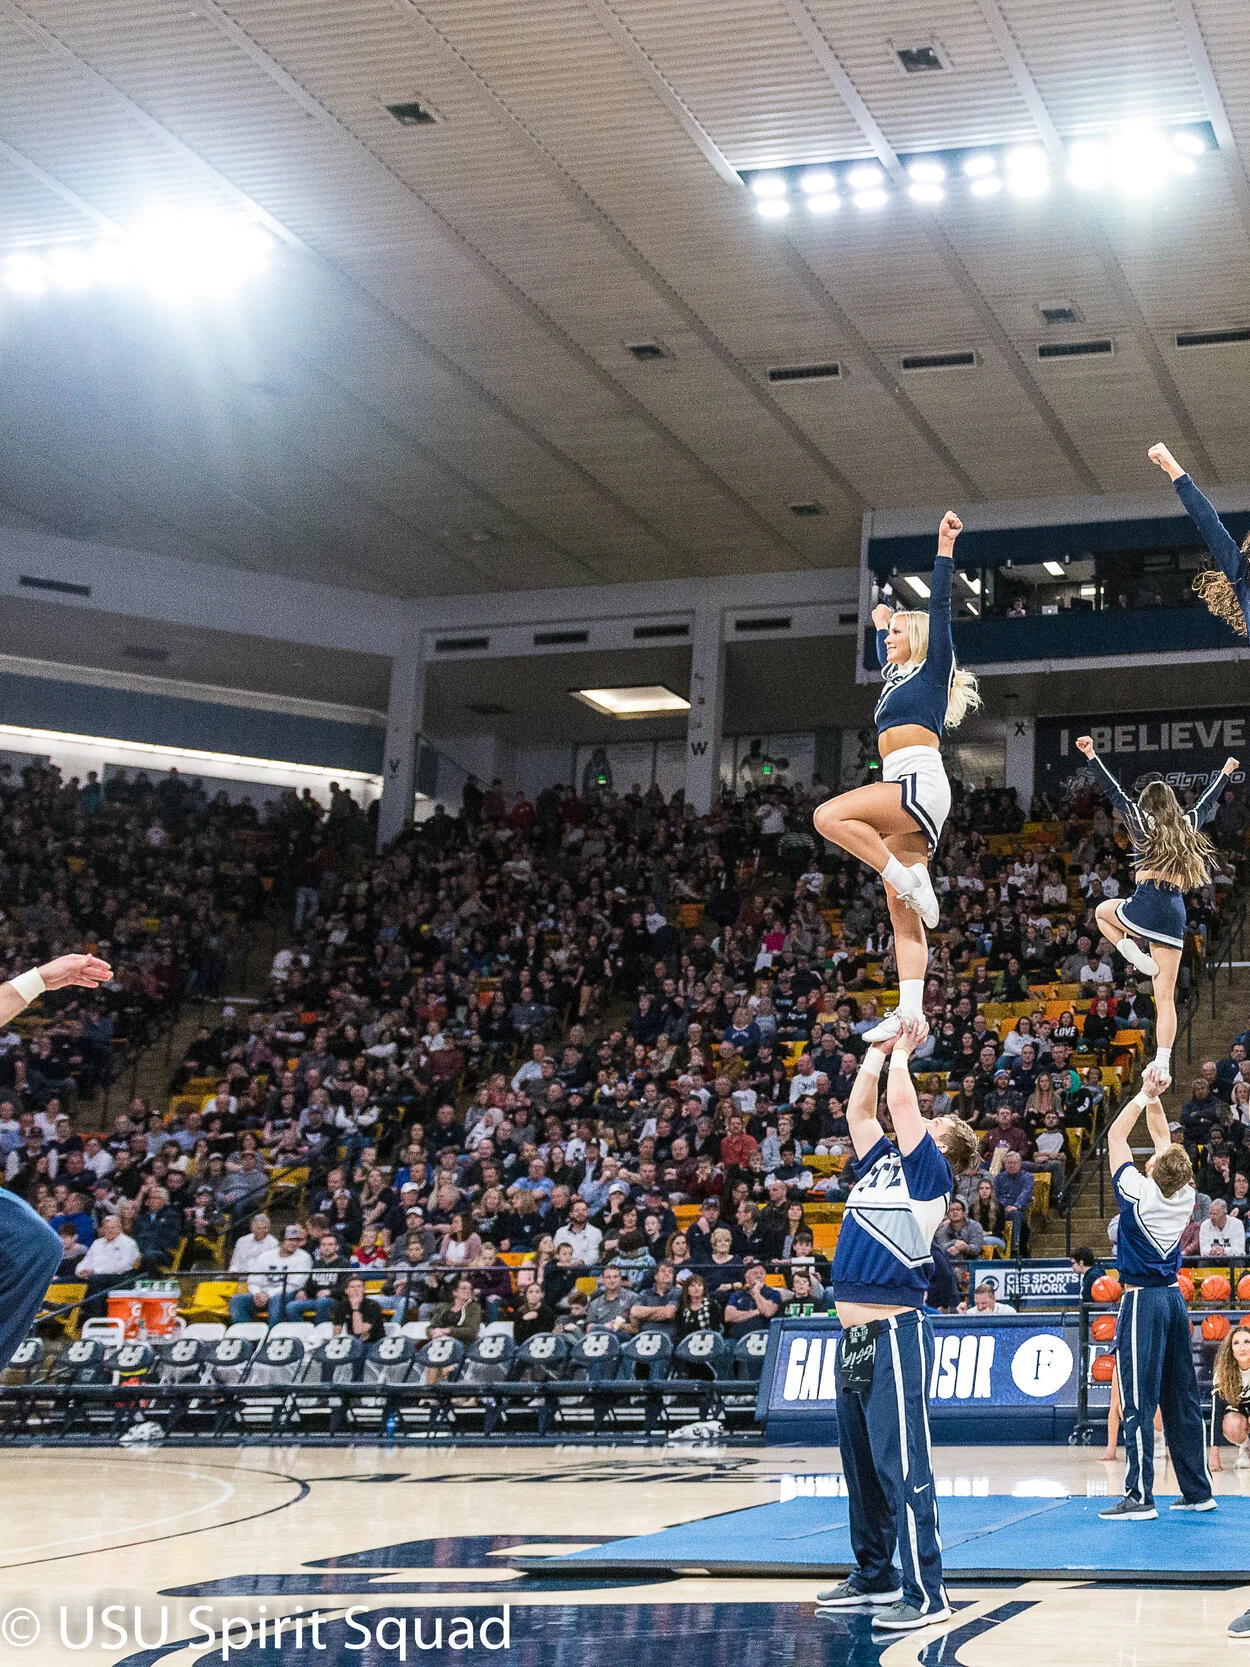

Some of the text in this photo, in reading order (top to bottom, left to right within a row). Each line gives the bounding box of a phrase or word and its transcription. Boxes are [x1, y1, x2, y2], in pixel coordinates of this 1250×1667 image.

[1014, 722, 1026, 736] X
[1060, 719, 1246, 756] I BELIEVE
[691, 741, 708, 755] W
[1054, 1026, 1076, 1037] LOVE
[1032, 1272, 1080, 1283] SPORTS
